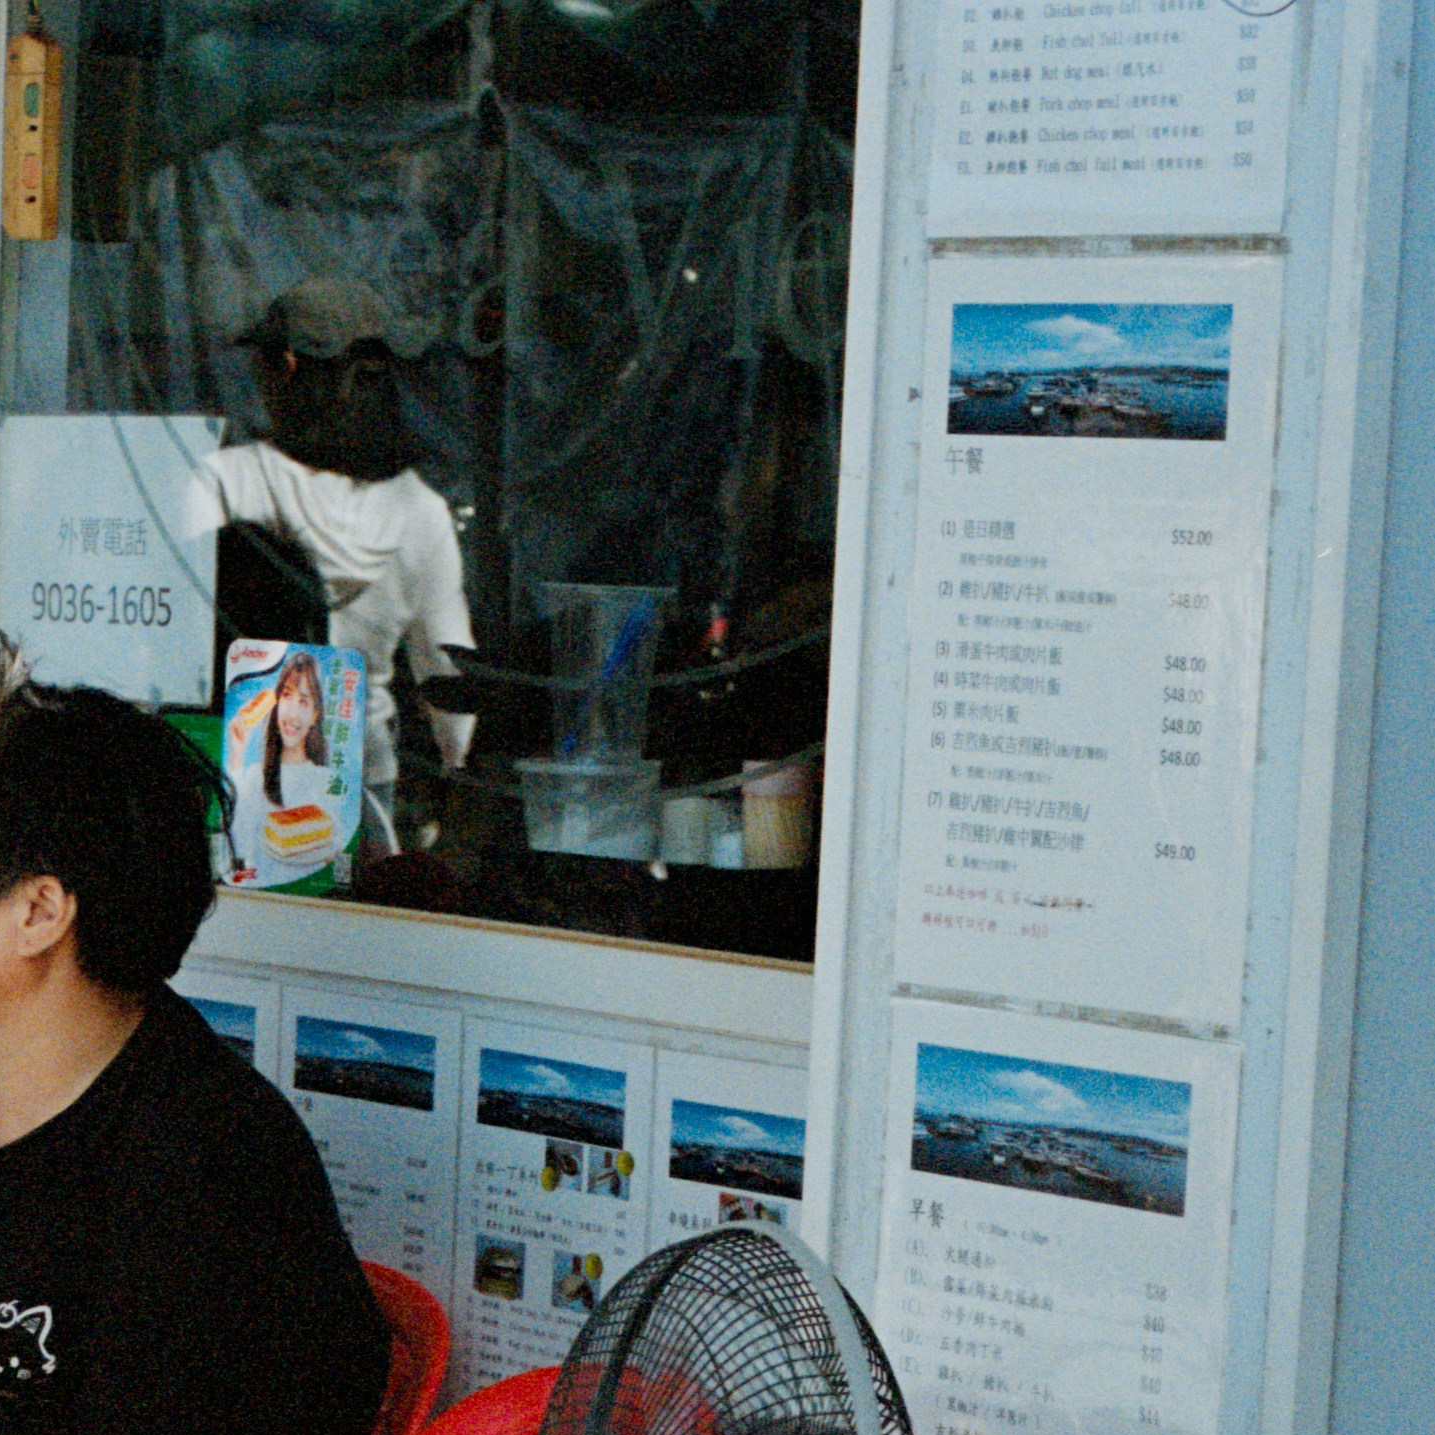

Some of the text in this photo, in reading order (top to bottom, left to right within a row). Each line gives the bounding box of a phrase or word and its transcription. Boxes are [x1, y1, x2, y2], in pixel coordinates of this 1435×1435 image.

[1037, 127, 1079, 143] Chicken
[1036, 158, 1061, 174] Fish
[945, 446, 984, 475] 午餐
[58, 516, 147, 555] 外賣電話
[941, 520, 956, 538] (1)
[1172, 529, 1213, 546] $52.00
[938, 580, 953, 599] (2)
[32, 582, 172, 627] 9036-1605
[1167, 592, 1209, 610] $48.00
[936, 640, 950, 659] (3)
[1164, 655, 1206, 673] $48.00
[934, 671, 949, 690] (4)
[1162, 686, 1204, 704] $48.00
[932, 701, 947, 720] (5)
[1161, 716, 1203, 736] $48.00
[930, 731, 945, 749] (6)
[1160, 749, 1201, 767] $48.00
[928, 791, 943, 810] (7)
[1155, 842, 1196, 861] $49.00
[909, 1198, 944, 1229] 早餐
